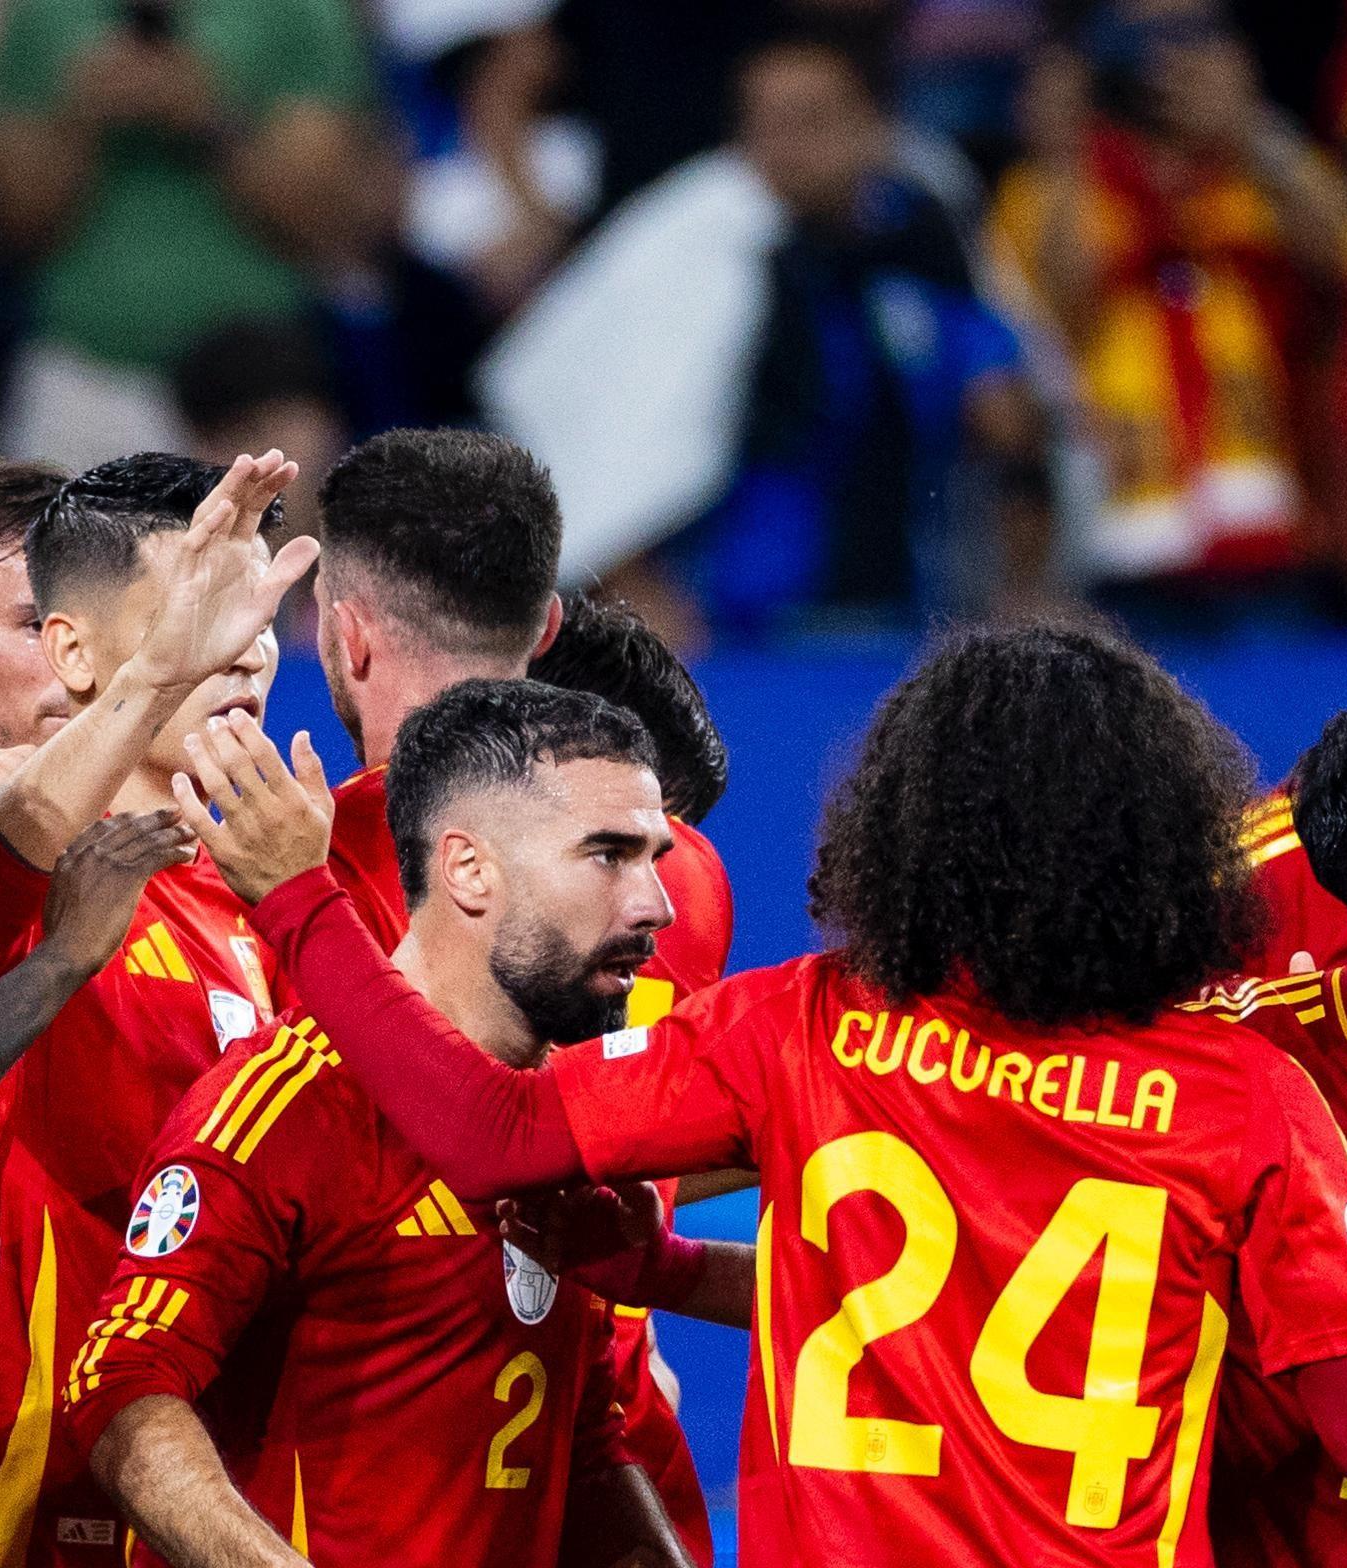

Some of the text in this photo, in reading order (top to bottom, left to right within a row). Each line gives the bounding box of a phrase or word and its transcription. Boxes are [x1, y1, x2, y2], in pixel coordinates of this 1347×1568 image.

[832, 1010, 1178, 1133] CUCURELLA
[790, 1131, 1168, 1528] 24
[485, 1351, 547, 1490] 2
